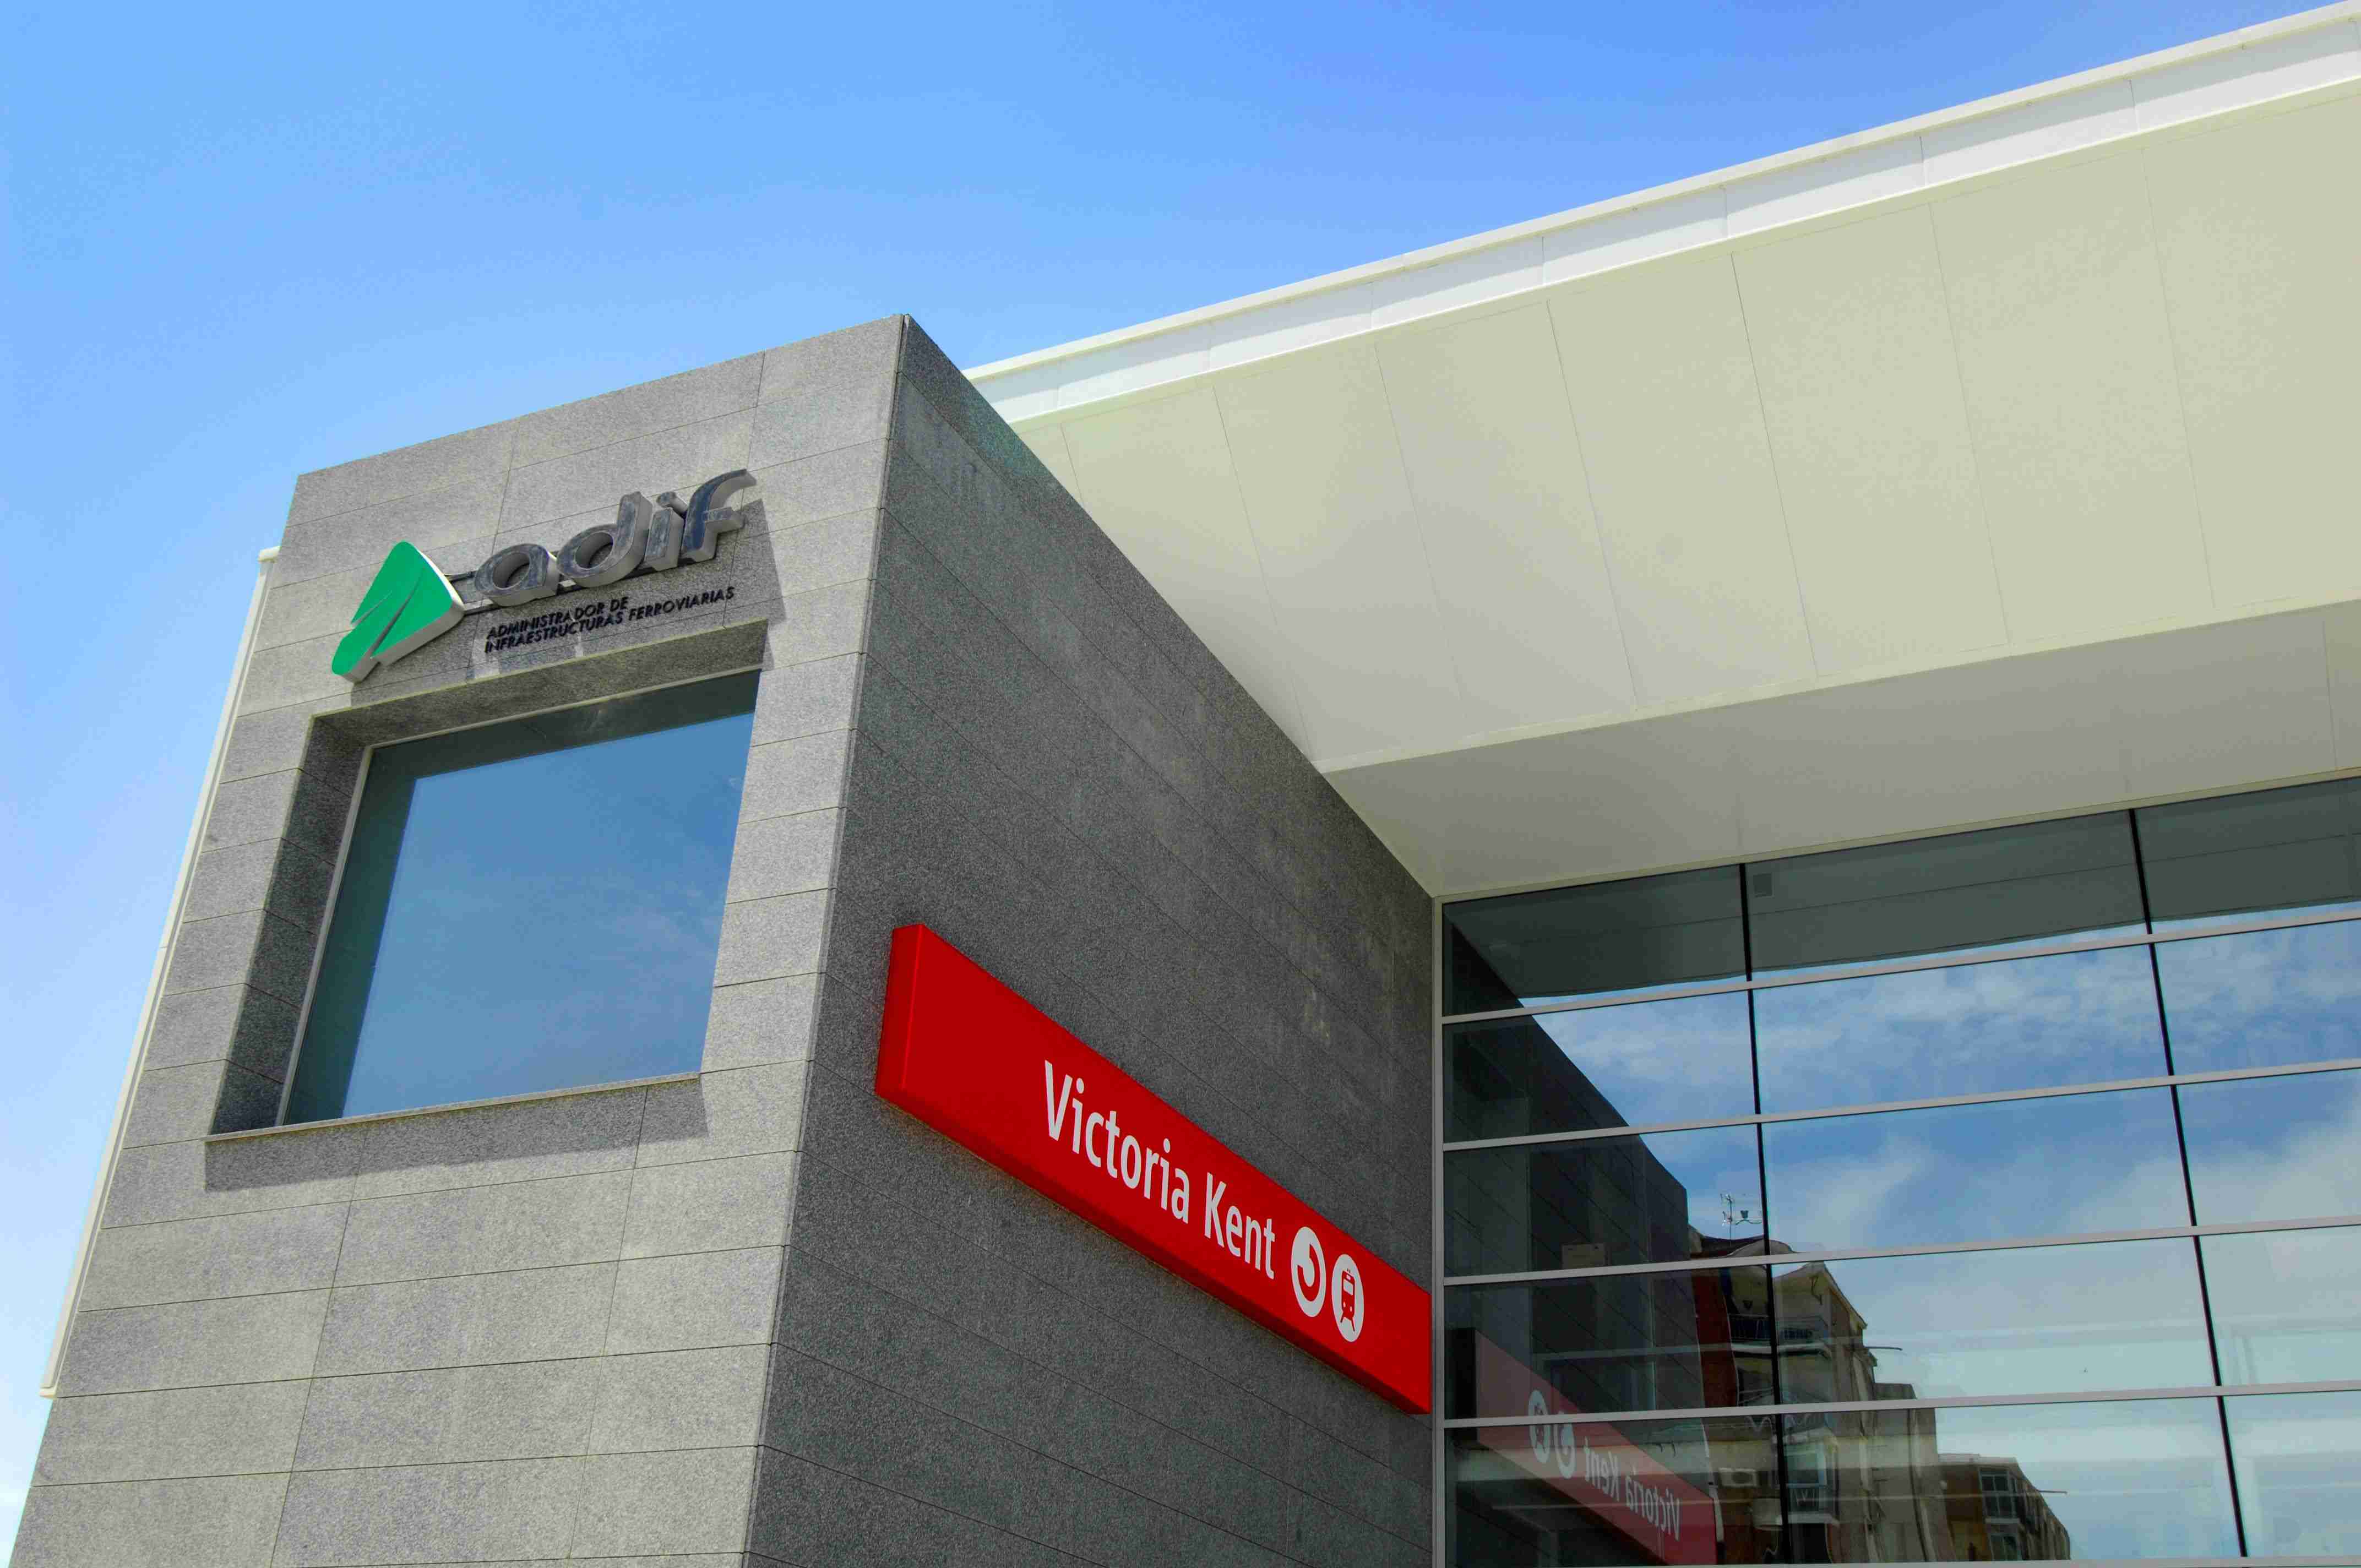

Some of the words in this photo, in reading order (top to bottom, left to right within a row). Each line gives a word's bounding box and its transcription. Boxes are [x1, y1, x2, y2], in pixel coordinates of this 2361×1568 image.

[475, 469, 757, 605] adif
[485, 612, 623, 654] INFRAESTRUCTURAS
[628, 586, 735, 622] FERROVIARIAS
[487, 605, 605, 639] ADMINISTRADOR
[610, 596, 629, 611] DE
[1045, 1060, 1190, 1224] Victoria
[1204, 1172, 1276, 1280] Kent
